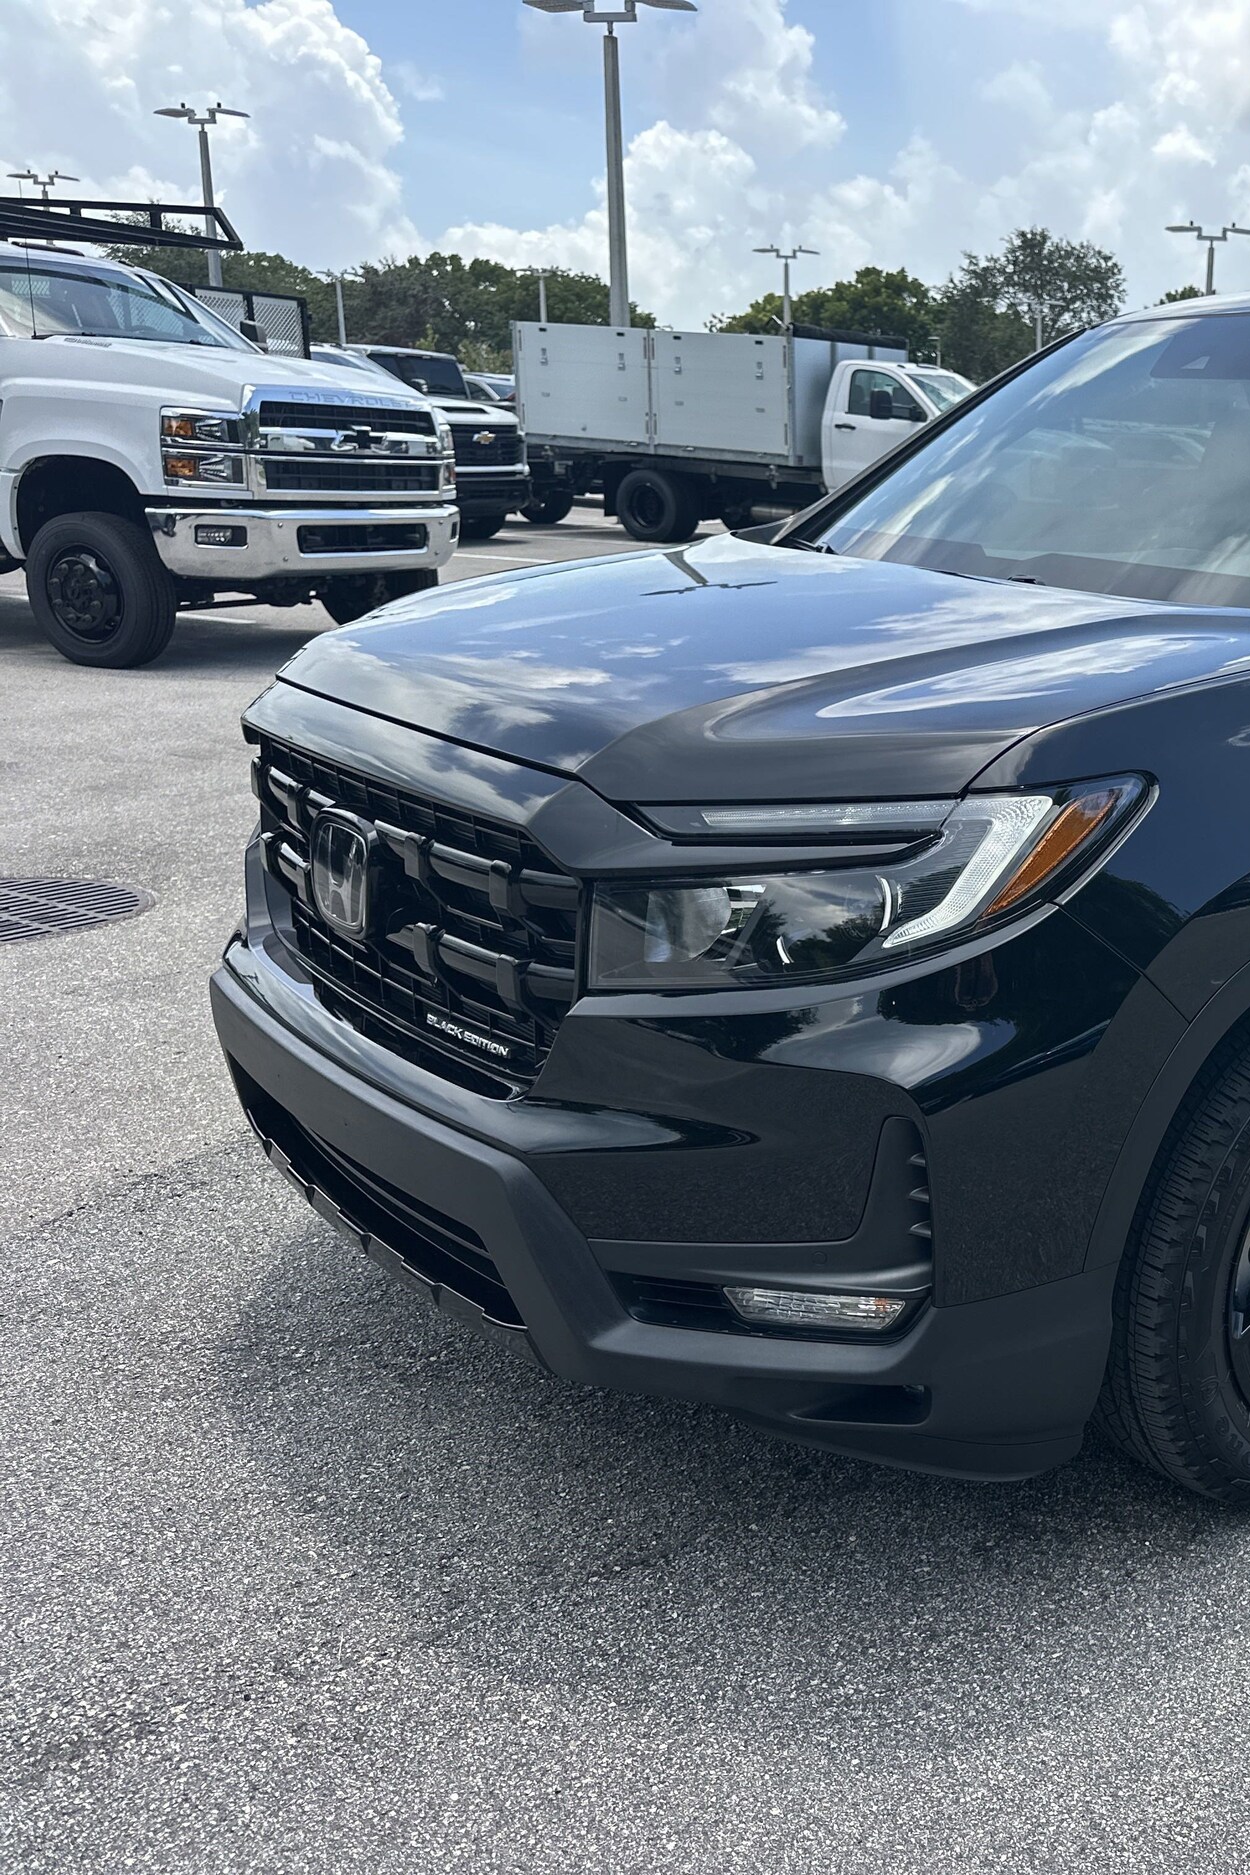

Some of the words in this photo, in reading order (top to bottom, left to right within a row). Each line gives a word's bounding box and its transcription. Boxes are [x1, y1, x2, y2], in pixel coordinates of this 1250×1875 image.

[288, 391, 415, 410] CHEVROLET
[426, 1013, 463, 1040] BLACK
[463, 1031, 510, 1057] EDITION
